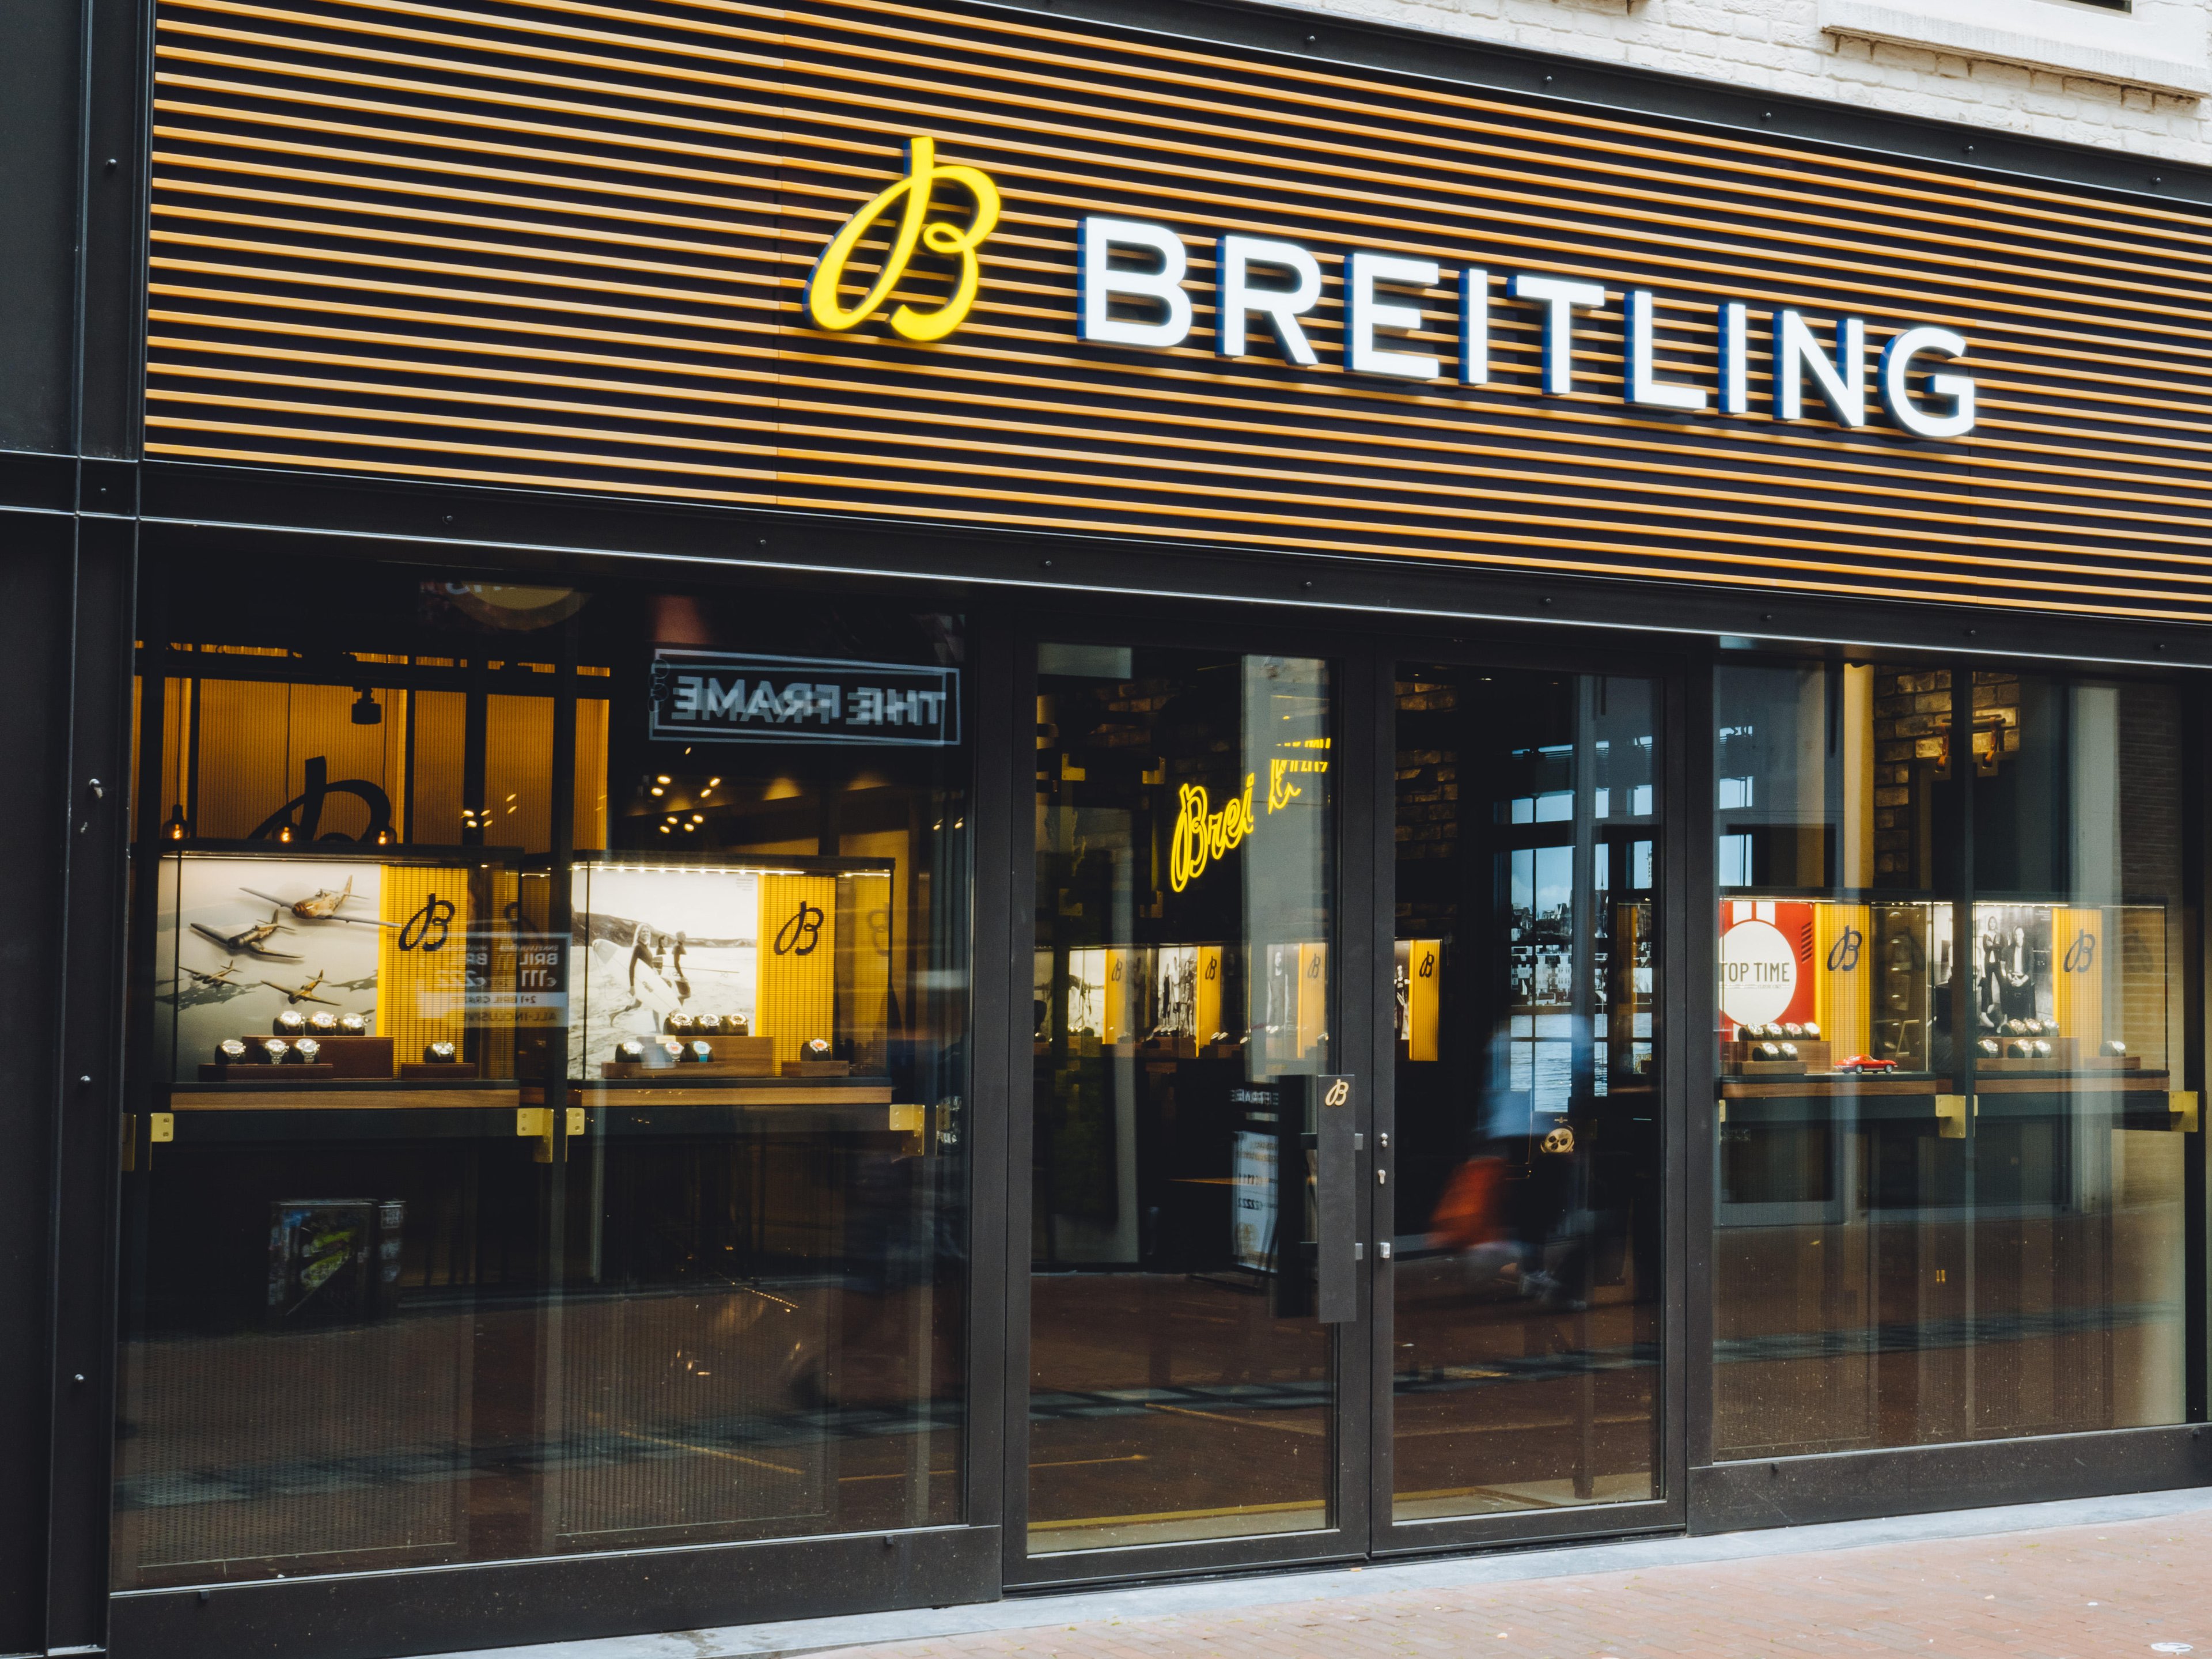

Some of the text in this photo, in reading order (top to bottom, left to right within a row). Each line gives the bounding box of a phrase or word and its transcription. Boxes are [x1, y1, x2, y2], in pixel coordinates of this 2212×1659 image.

[803, 135, 1976, 438] B BREITLING
[1753, 962, 1790, 982] TIME
[1325, 1078, 1350, 1107] B
